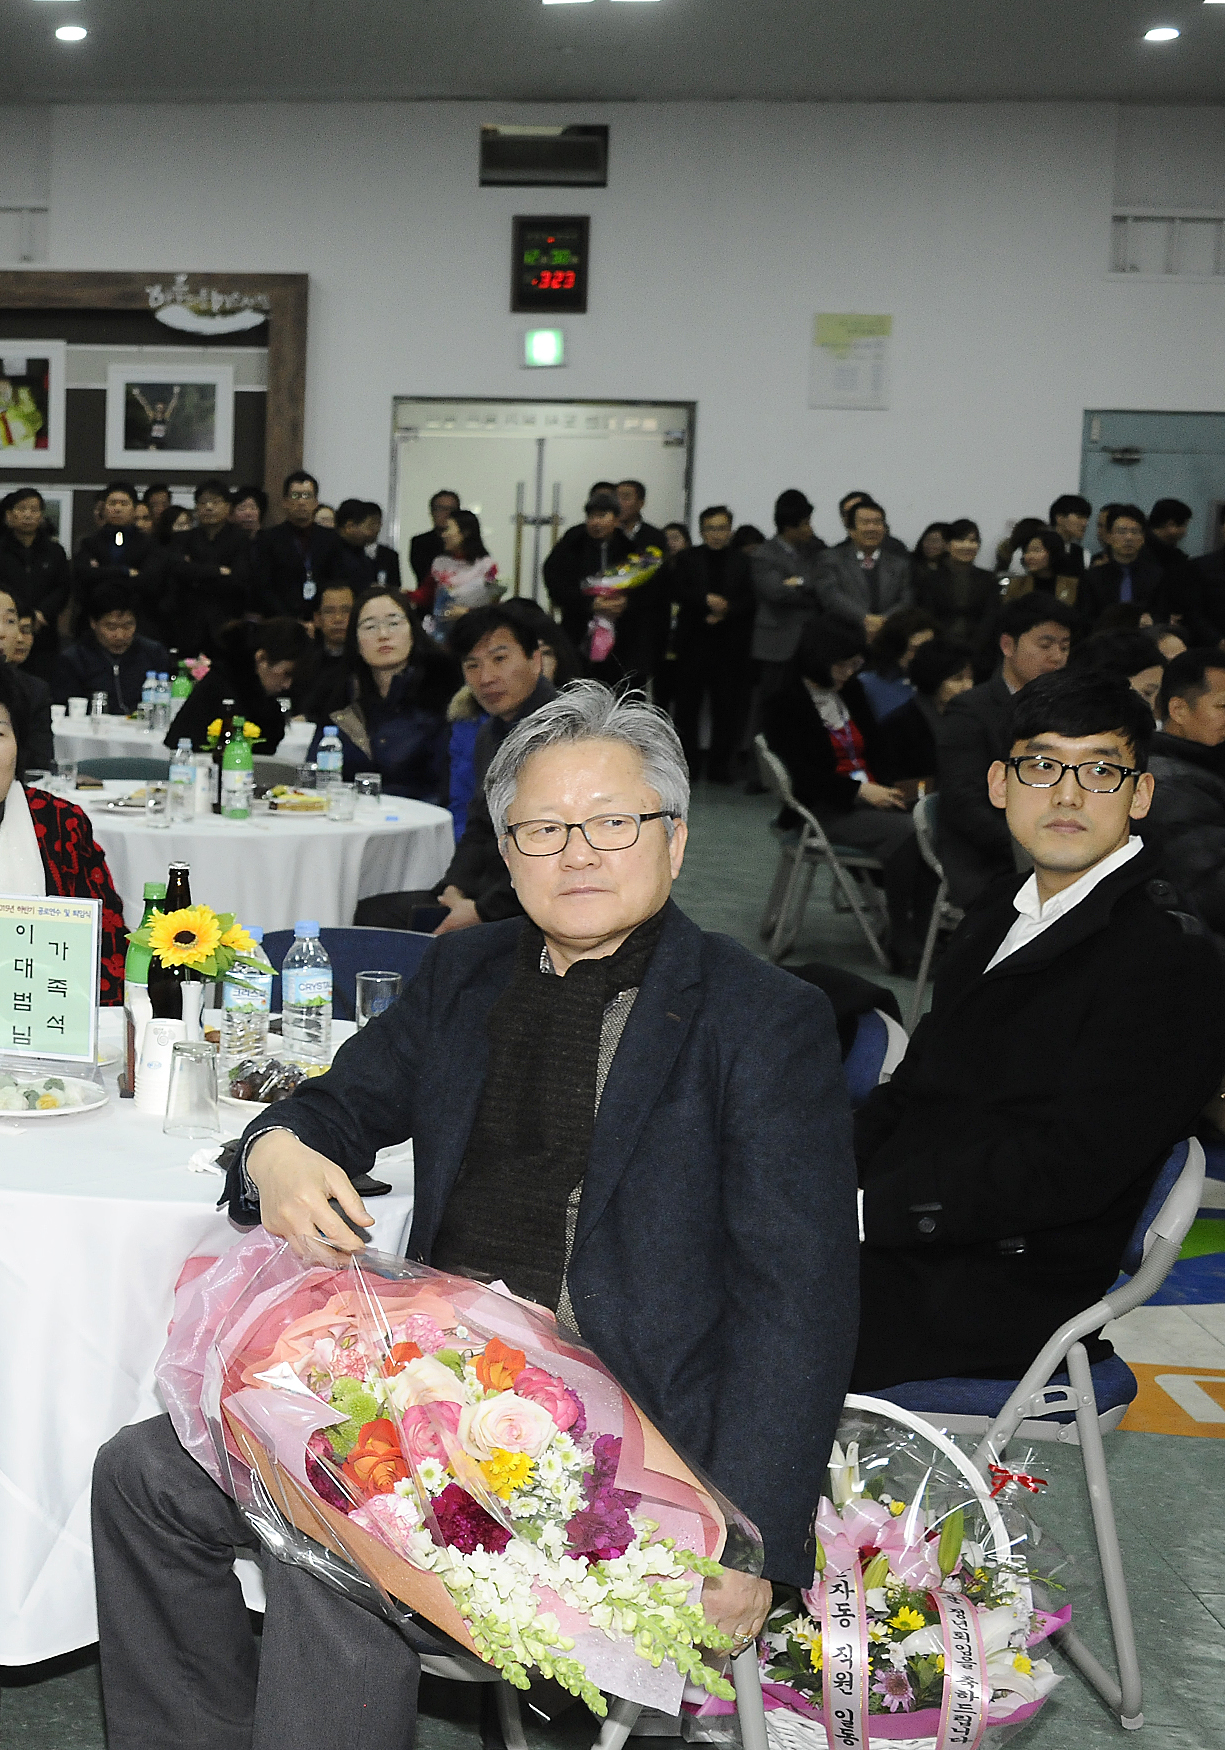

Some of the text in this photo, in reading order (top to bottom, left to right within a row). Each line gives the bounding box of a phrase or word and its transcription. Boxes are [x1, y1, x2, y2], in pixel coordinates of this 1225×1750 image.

[37, 907, 61, 917] 공로연수
[46, 941, 69, 1035] 가족석
[829, 1568, 860, 1747] 자동 직원 일동
